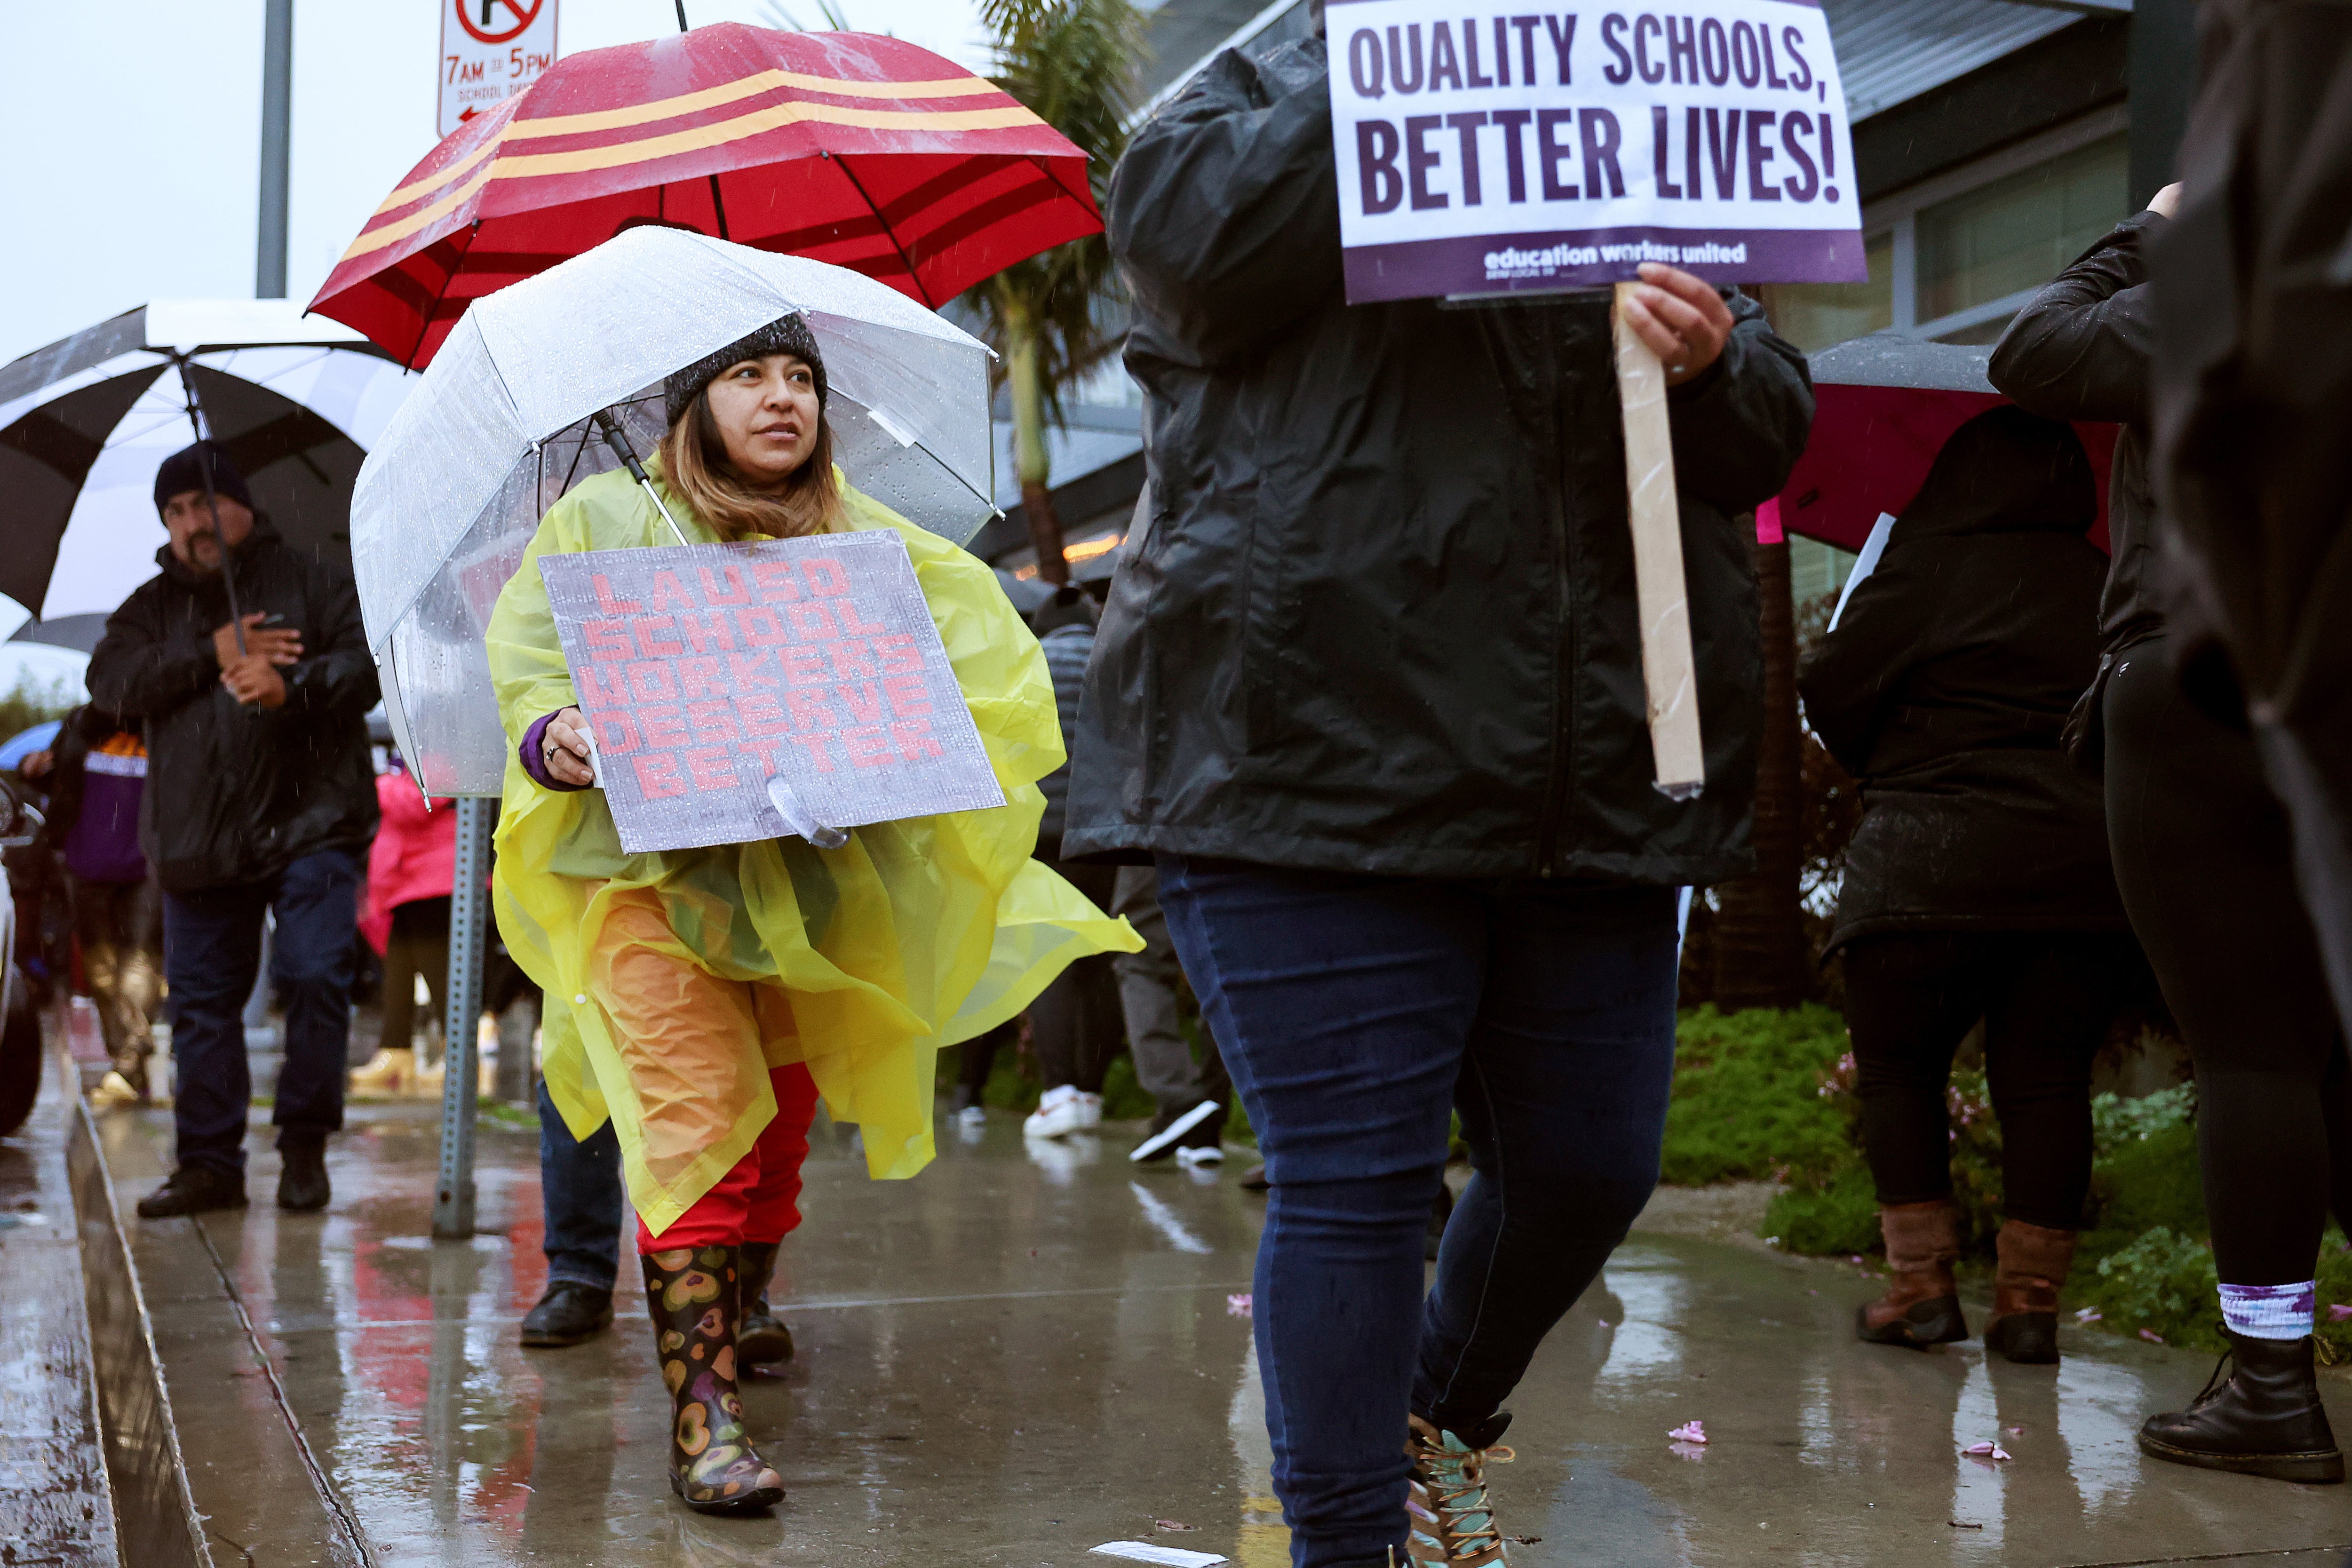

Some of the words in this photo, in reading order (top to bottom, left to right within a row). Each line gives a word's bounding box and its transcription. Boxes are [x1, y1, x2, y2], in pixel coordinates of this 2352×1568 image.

[446, 55, 485, 85] 7AM
[510, 48, 550, 79] 5PM
[1348, 14, 1578, 100] QUALITY
[1600, 13, 1827, 102] SCHOOLS,
[458, 85, 501, 102] SCHOOL
[1355, 107, 1627, 216] BETTER
[1650, 105, 1840, 203] LIVES!
[1484, 242, 1597, 270] education
[1600, 239, 1680, 263] workers
[1681, 242, 1747, 264] united
[591, 558, 850, 613] LAUSD
[582, 598, 886, 661] SCHOOL
[577, 633, 927, 709] WORKERS
[589, 675, 934, 756] DESERVE
[631, 720, 945, 800] BETTER
